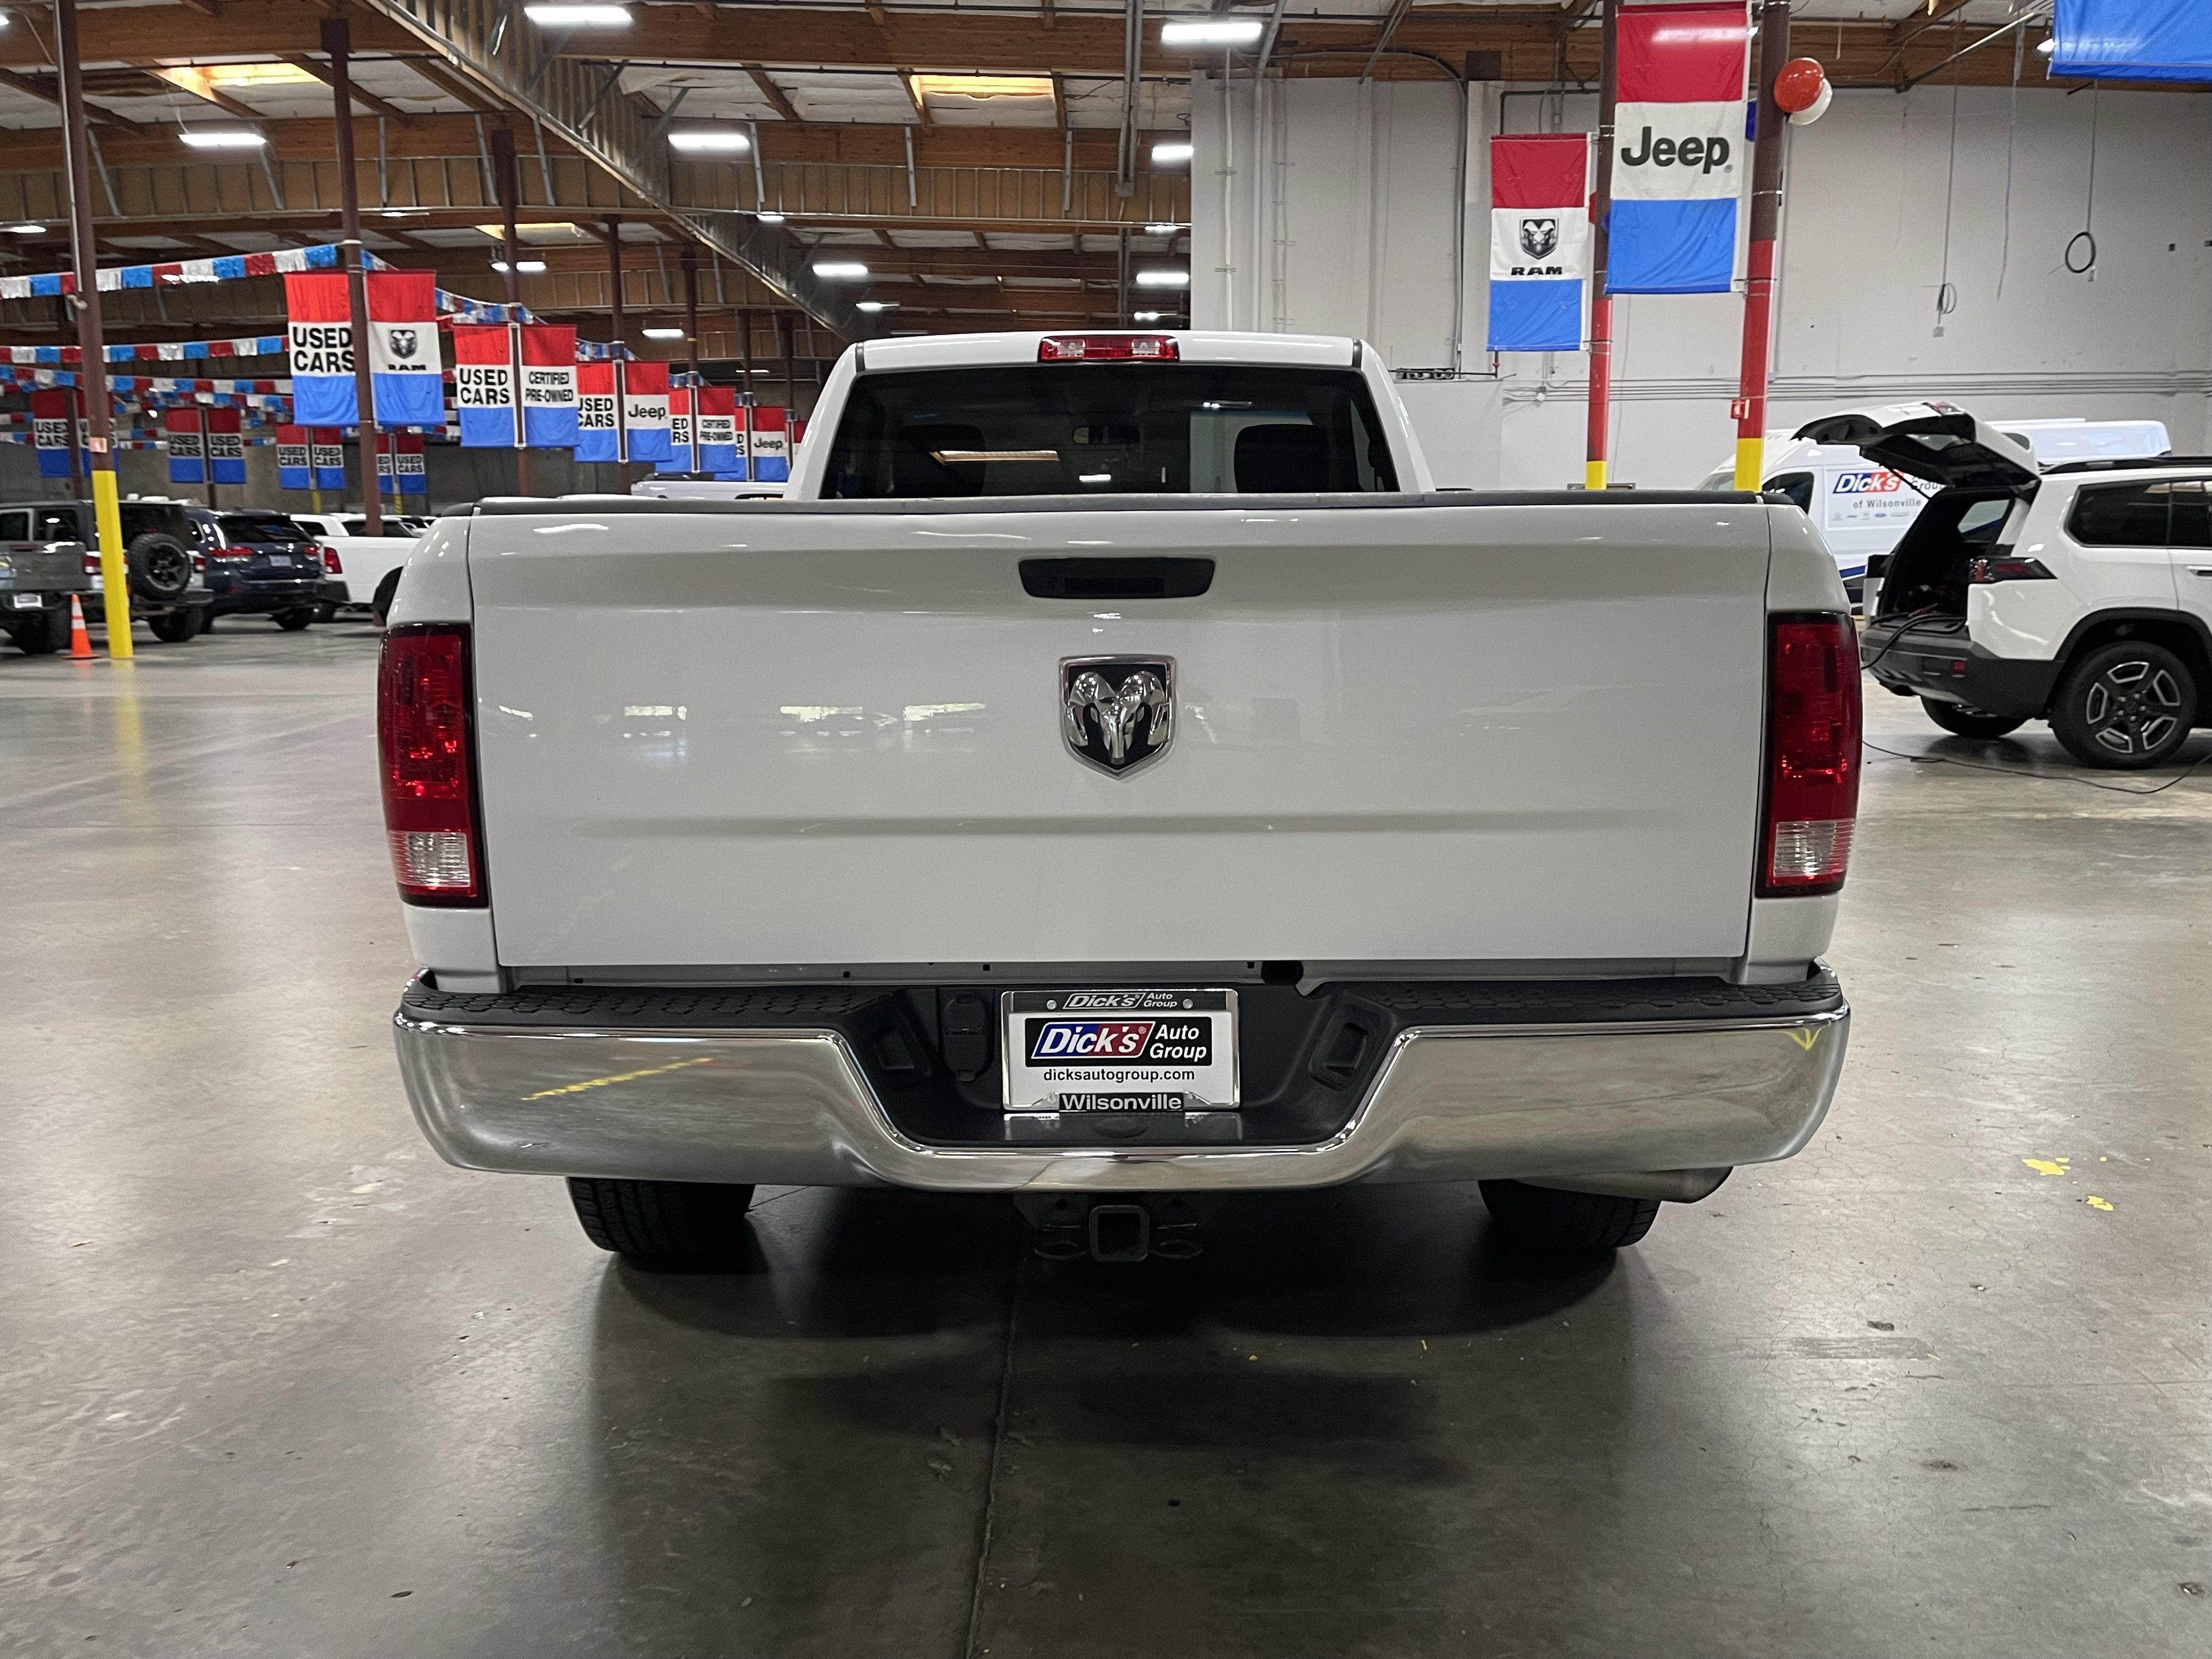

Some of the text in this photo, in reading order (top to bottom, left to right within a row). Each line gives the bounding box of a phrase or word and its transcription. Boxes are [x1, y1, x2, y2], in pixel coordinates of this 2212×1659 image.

[1621, 126, 1730, 174] Jeep
[1511, 266, 1562, 276] RAM
[293, 326, 352, 349] USED
[294, 351, 355, 373] CARS
[460, 368, 507, 386] USED
[529, 371, 569, 385] CERTIFIED
[460, 387, 510, 404] CARS
[526, 388, 573, 402] PRE-OWNED
[628, 404, 665, 420] Jeep
[672, 418, 688, 430] ED
[673, 431, 689, 443] RS
[754, 438, 783, 450] Jeep
[278, 447, 306, 456] USED
[314, 447, 341, 456] USED
[279, 456, 307, 466] CARS
[314, 456, 342, 466] CARS
[398, 464, 423, 473] CARS
[1836, 472, 1900, 492] Dick's
[1853, 498, 1921, 508] of Wilsonville
[1068, 992, 1173, 1008] Dick's Auto
[1143, 1000, 1177, 1008] Group
[1040, 1024, 1199, 1054] Dick's Auto
[1150, 1043, 1207, 1062] Group
[1043, 1069, 1195, 1083] dicksautogroup.com
[1062, 1094, 1182, 1110] Wilsonville
